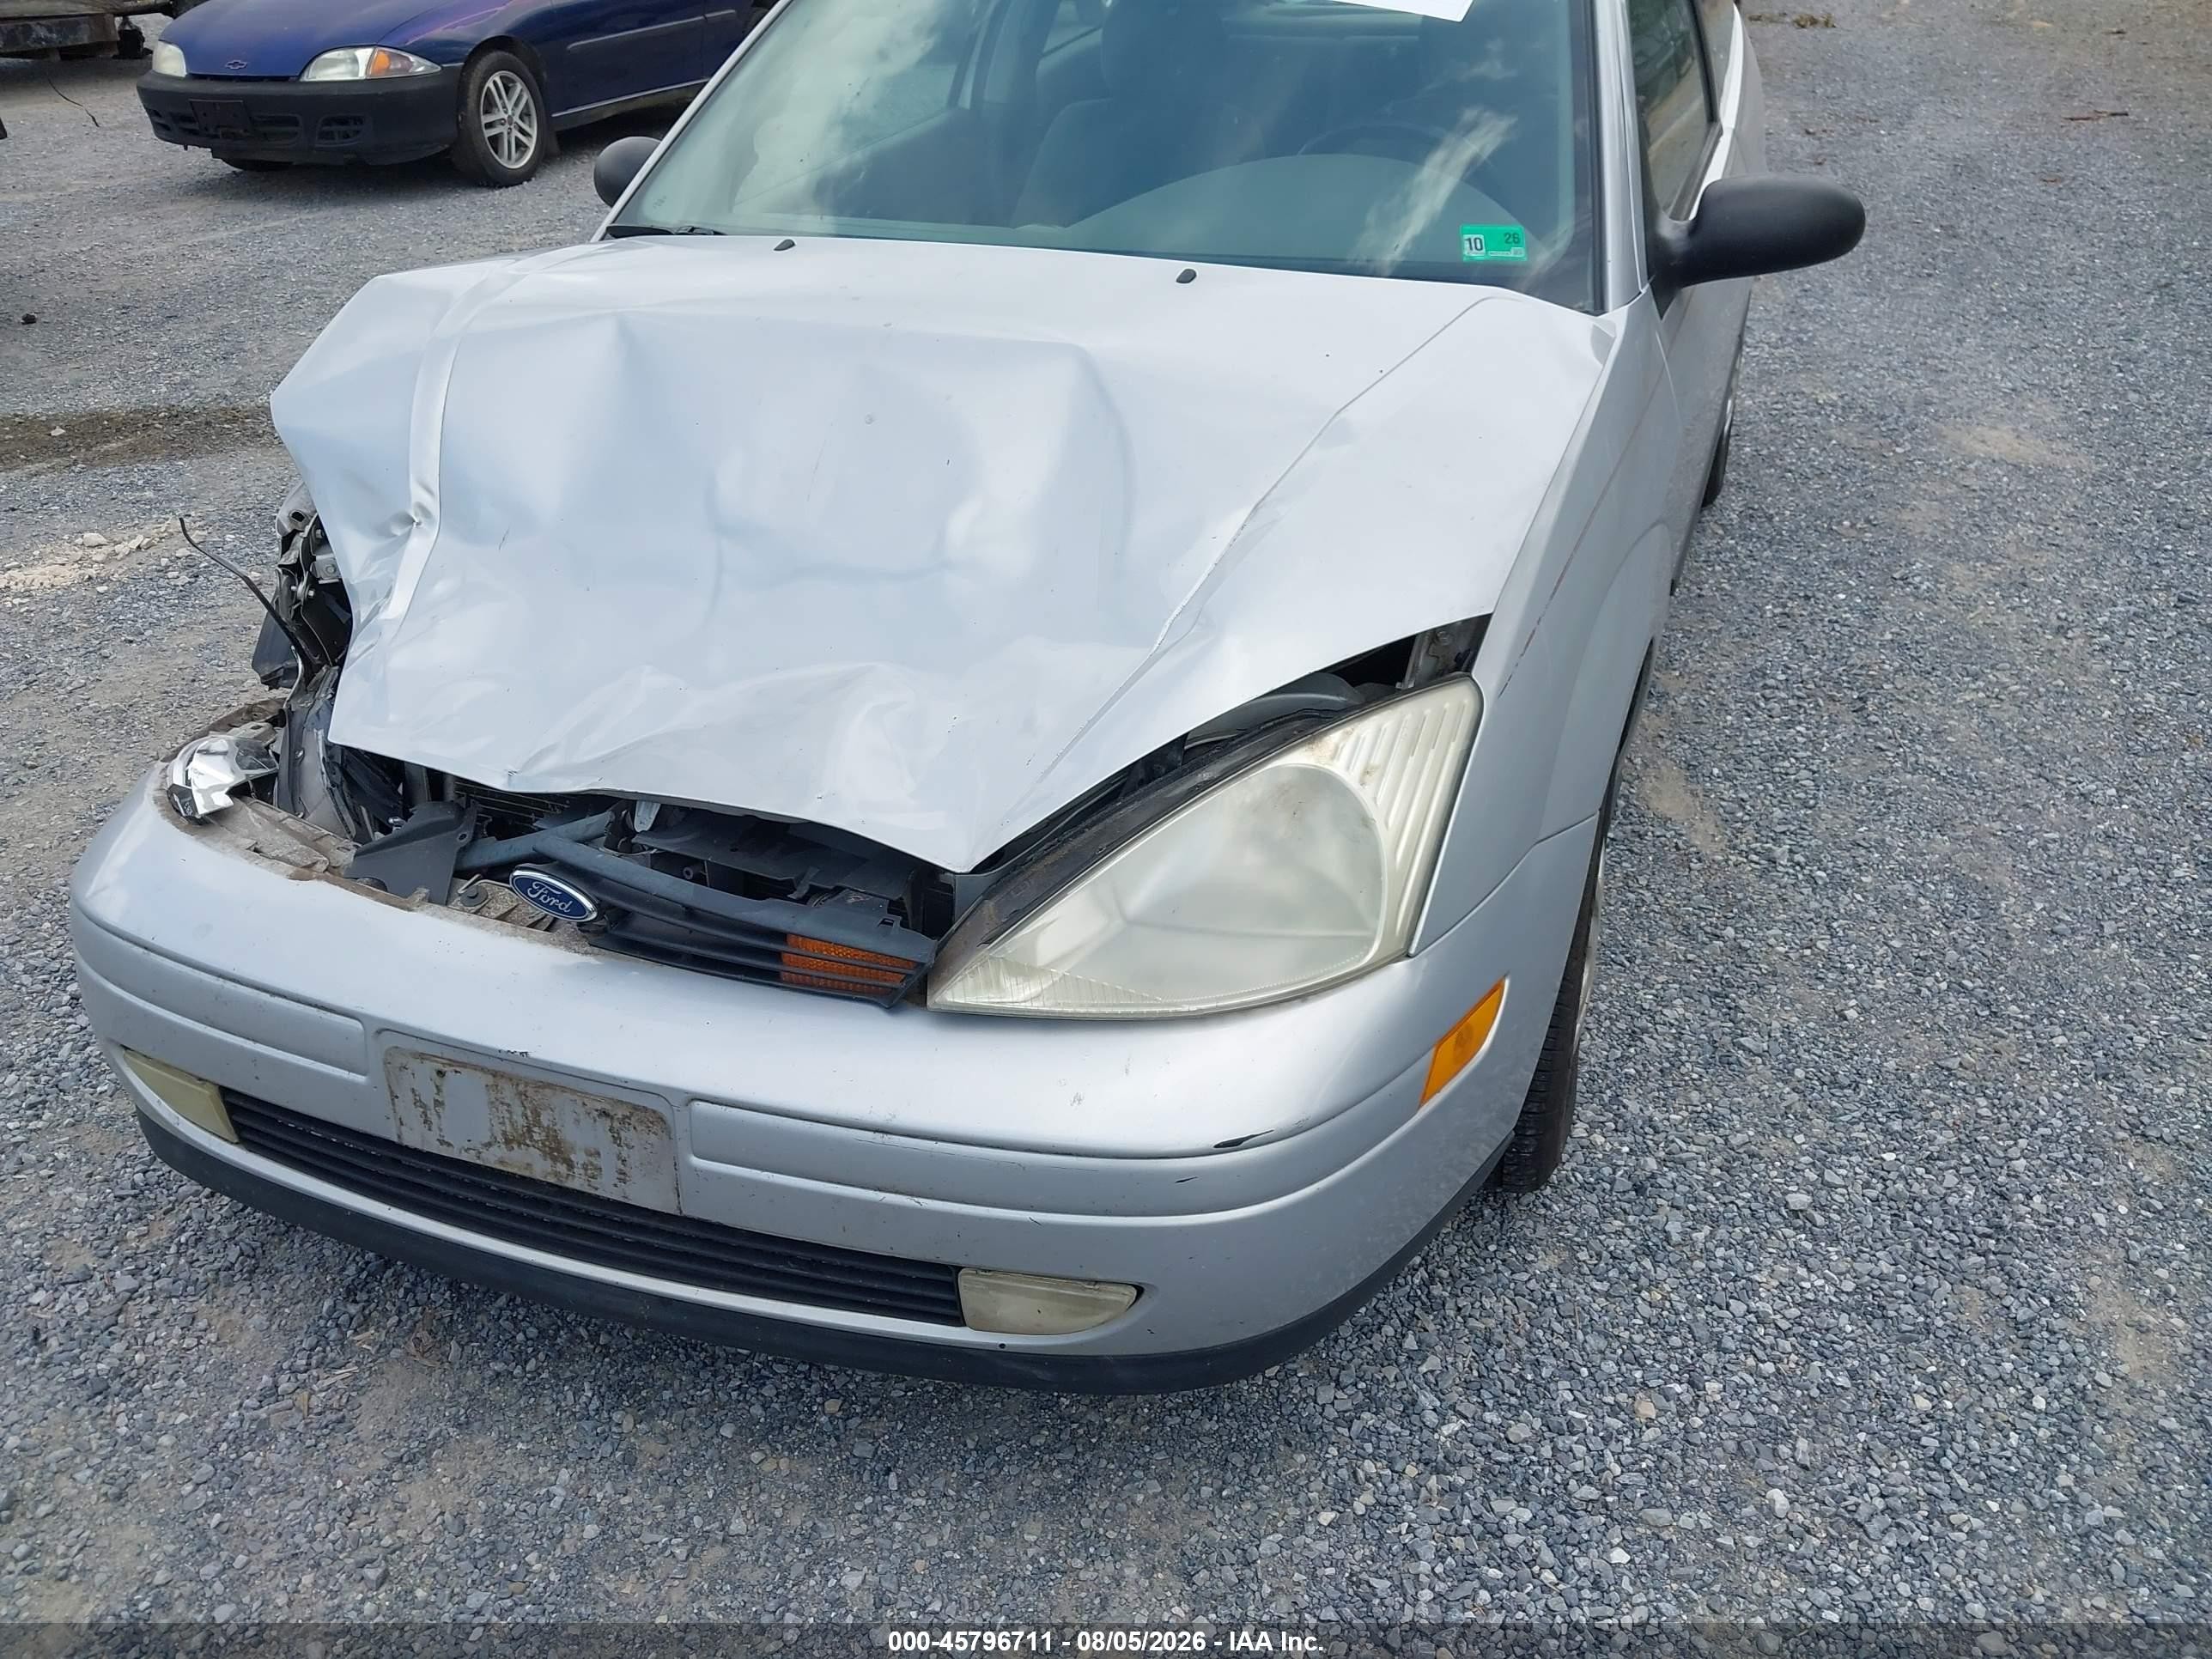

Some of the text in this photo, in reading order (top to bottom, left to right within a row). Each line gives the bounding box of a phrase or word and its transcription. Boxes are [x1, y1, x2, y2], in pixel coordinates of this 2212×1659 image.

[1465, 237, 1484, 252] 10
[1504, 232, 1521, 245] 26
[526, 881, 573, 913] Ford
